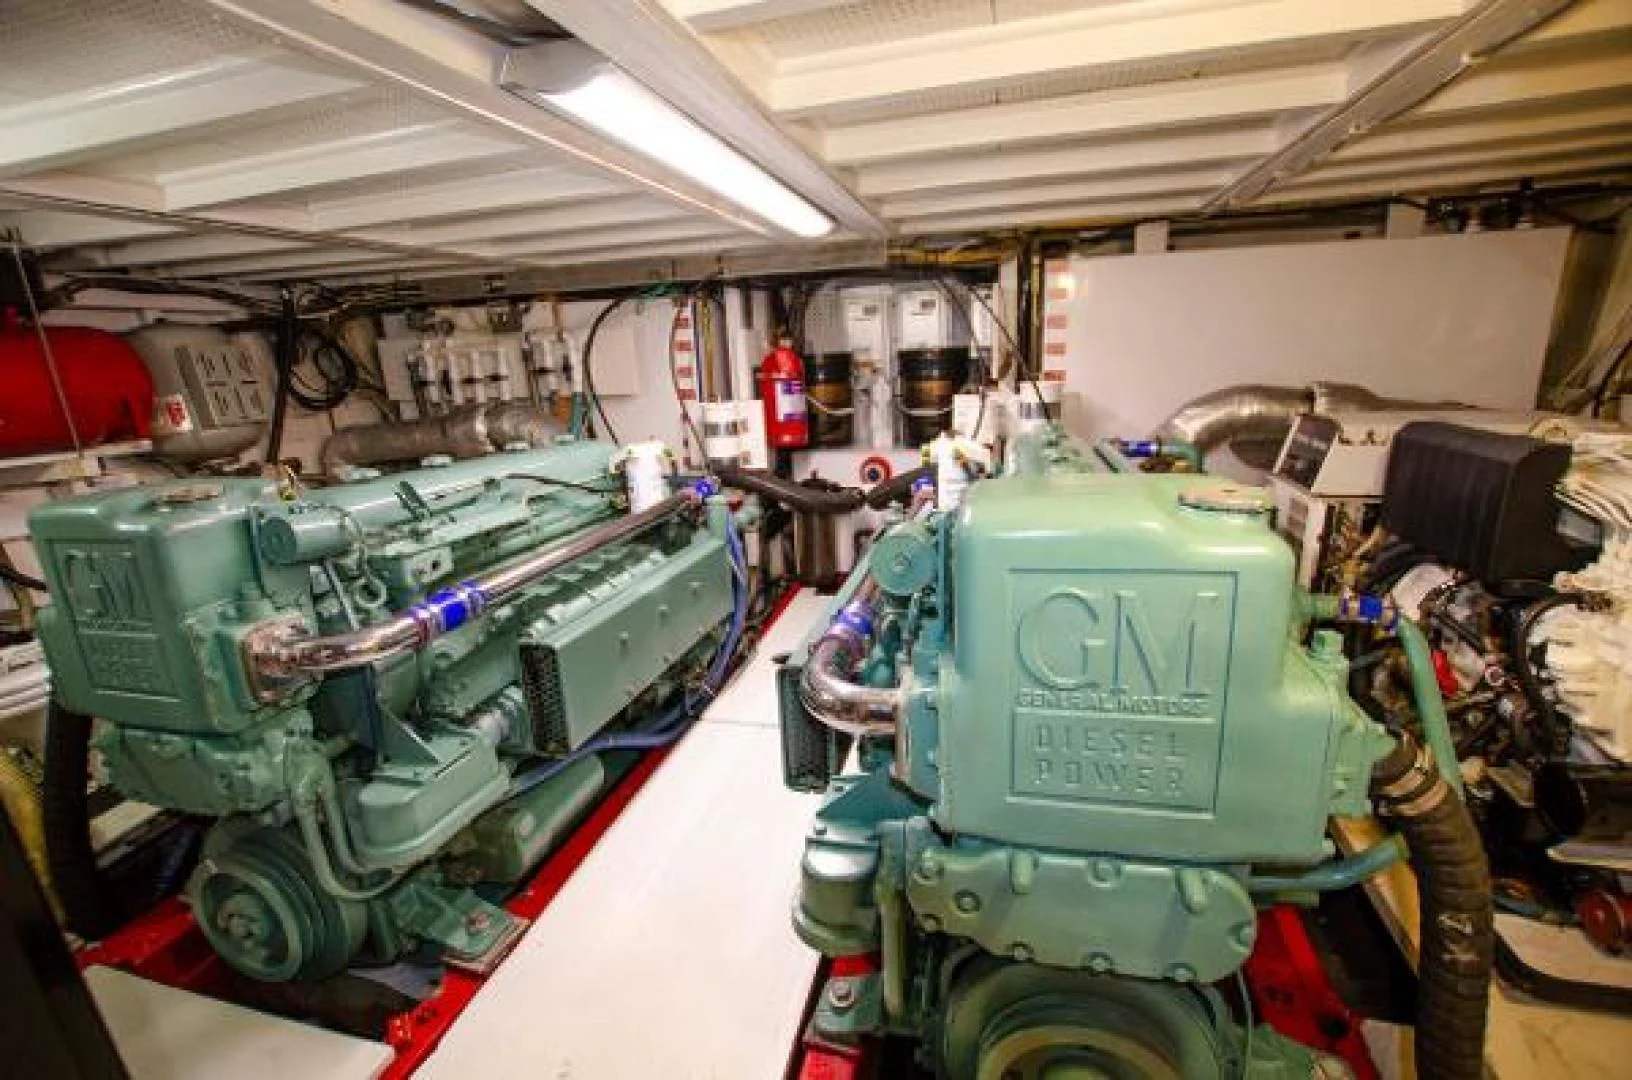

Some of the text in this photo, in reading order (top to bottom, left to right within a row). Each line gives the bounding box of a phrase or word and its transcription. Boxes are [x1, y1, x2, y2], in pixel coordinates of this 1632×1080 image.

[63, 549, 152, 621] GM
[1014, 586, 1218, 696] GM
[1036, 725, 1185, 760] DIESEL
[1036, 758, 1182, 796] POWER
